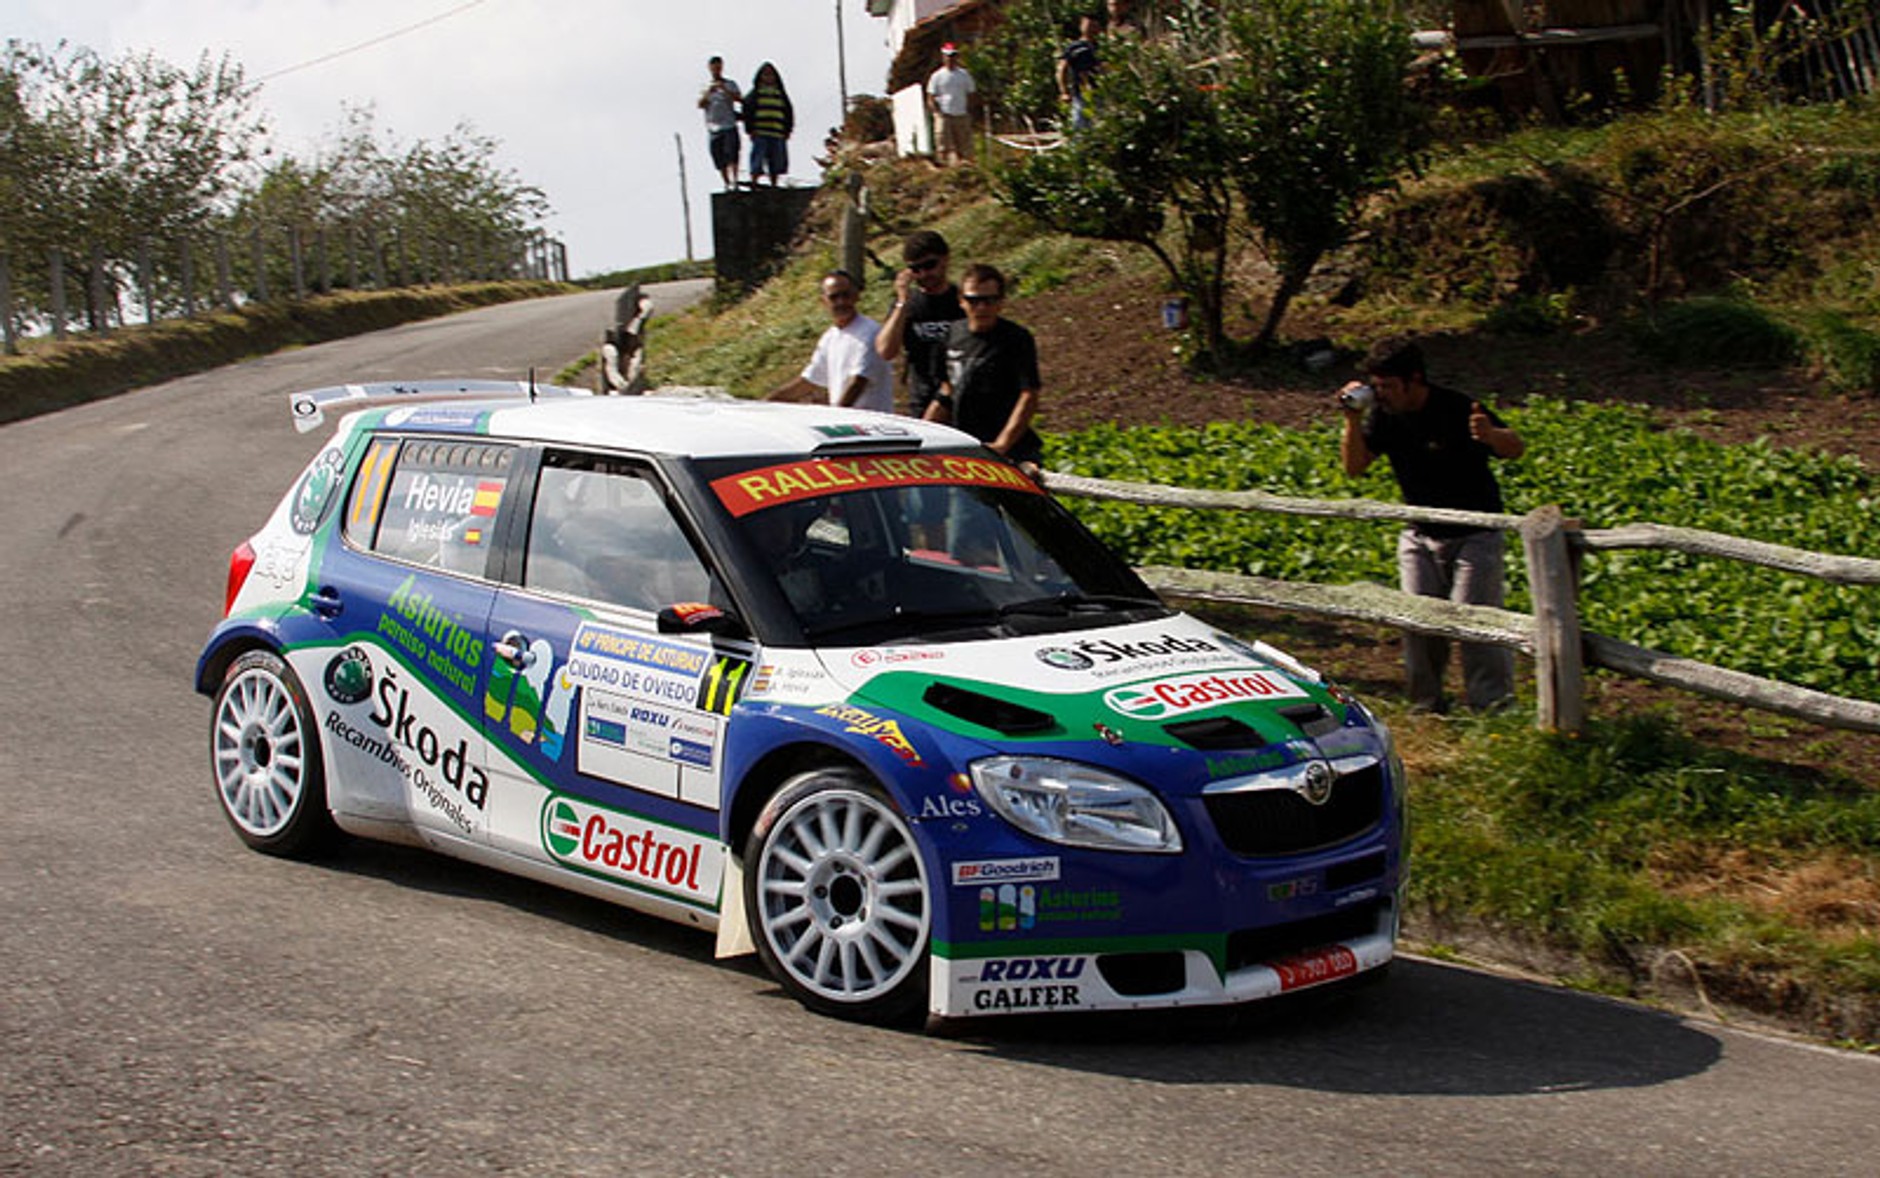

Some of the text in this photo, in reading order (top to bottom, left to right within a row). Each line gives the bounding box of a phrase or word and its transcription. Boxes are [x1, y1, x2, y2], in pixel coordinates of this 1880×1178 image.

[351, 442, 400, 525] 11
[404, 474, 475, 514] Hevia
[737, 457, 1029, 502] RALLY-IRC.COM
[388, 572, 485, 668] Asturias
[638, 643, 655, 662] DE
[653, 645, 704, 673] ASTURIAS
[1074, 633, 1222, 664] Škoda
[426, 648, 478, 697] natural
[568, 658, 698, 703] CIUDAD DE OVIEDO
[705, 655, 748, 718] 11
[1152, 672, 1289, 709] Castrol
[368, 665, 491, 811] Škoda
[630, 706, 670, 727] ROXU
[324, 710, 473, 835] Recambios Originales
[920, 794, 982, 817] Ales
[581, 813, 703, 891] Castrol
[980, 956, 1087, 983] ROXU
[973, 984, 1081, 1011] GALFER
